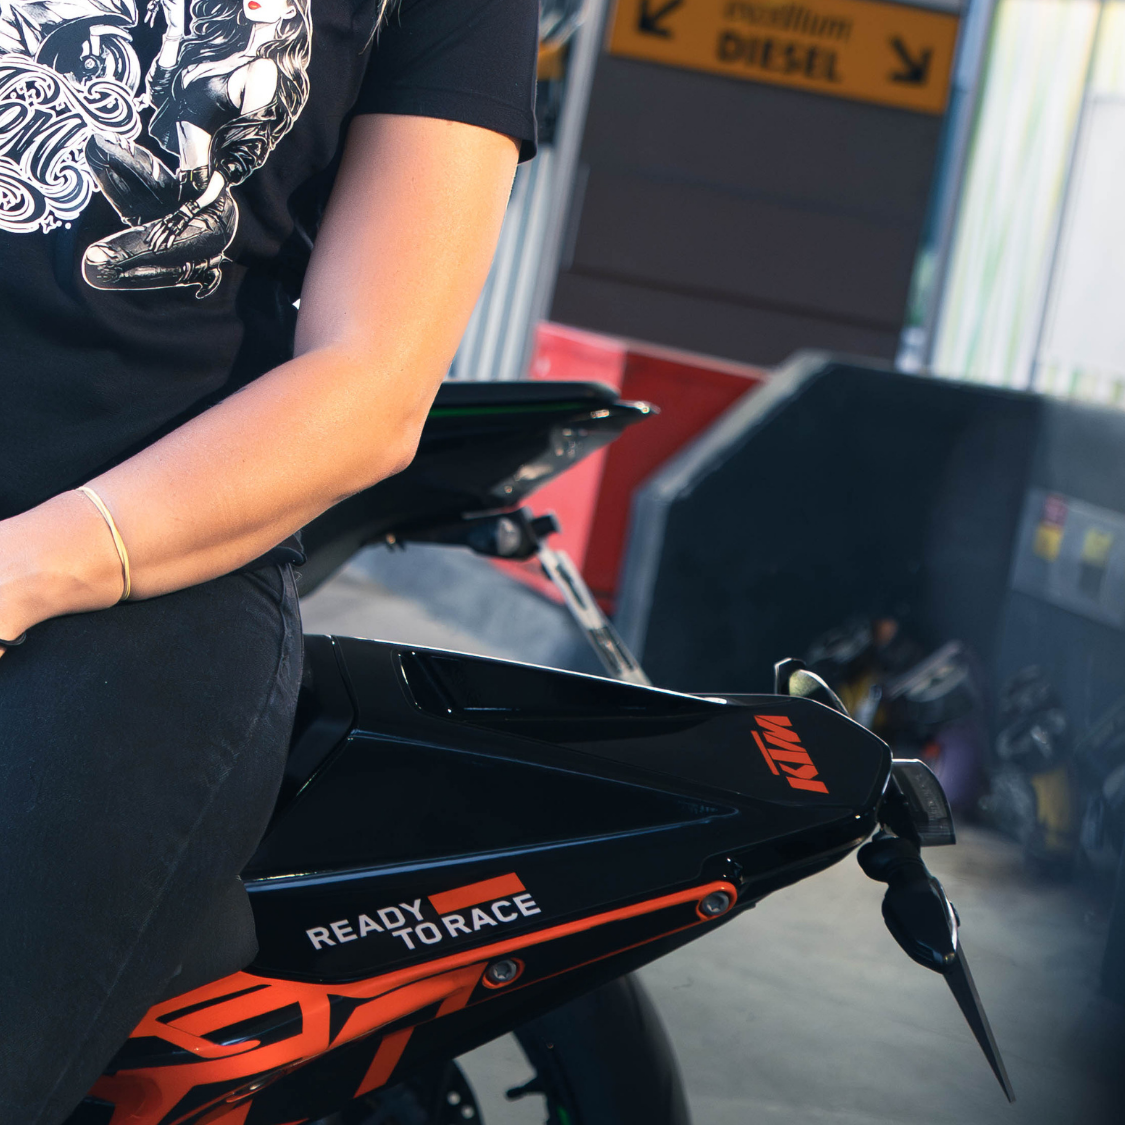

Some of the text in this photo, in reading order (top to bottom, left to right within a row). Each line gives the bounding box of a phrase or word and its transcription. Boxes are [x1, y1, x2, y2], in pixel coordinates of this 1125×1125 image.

[717, 30, 843, 84] DIESEL
[750, 714, 830, 794] KTM
[306, 898, 425, 950] READY
[392, 893, 542, 950] TO RACE
